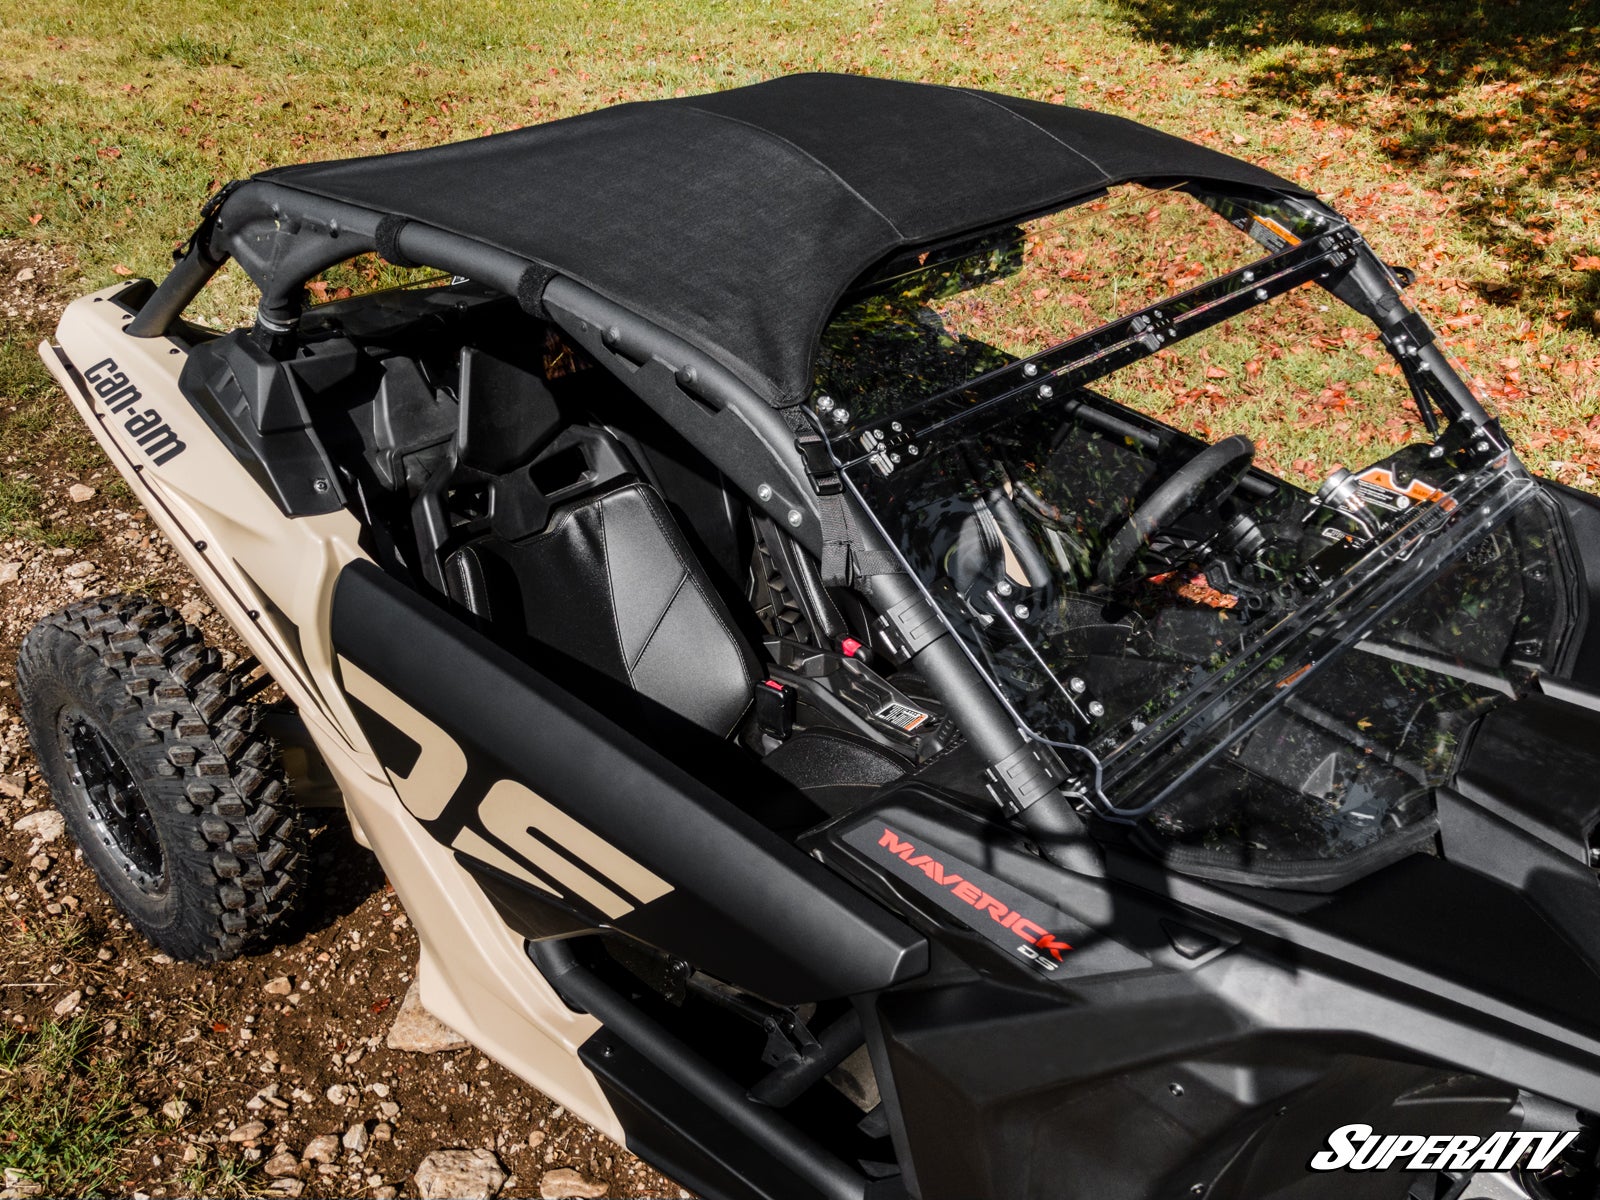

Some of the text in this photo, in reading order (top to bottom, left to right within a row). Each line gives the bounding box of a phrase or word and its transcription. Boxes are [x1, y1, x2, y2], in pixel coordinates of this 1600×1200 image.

[84, 357, 187, 467] can-am
[878, 828, 1073, 962] MAVERICK
[1017, 944, 1058, 971] DS
